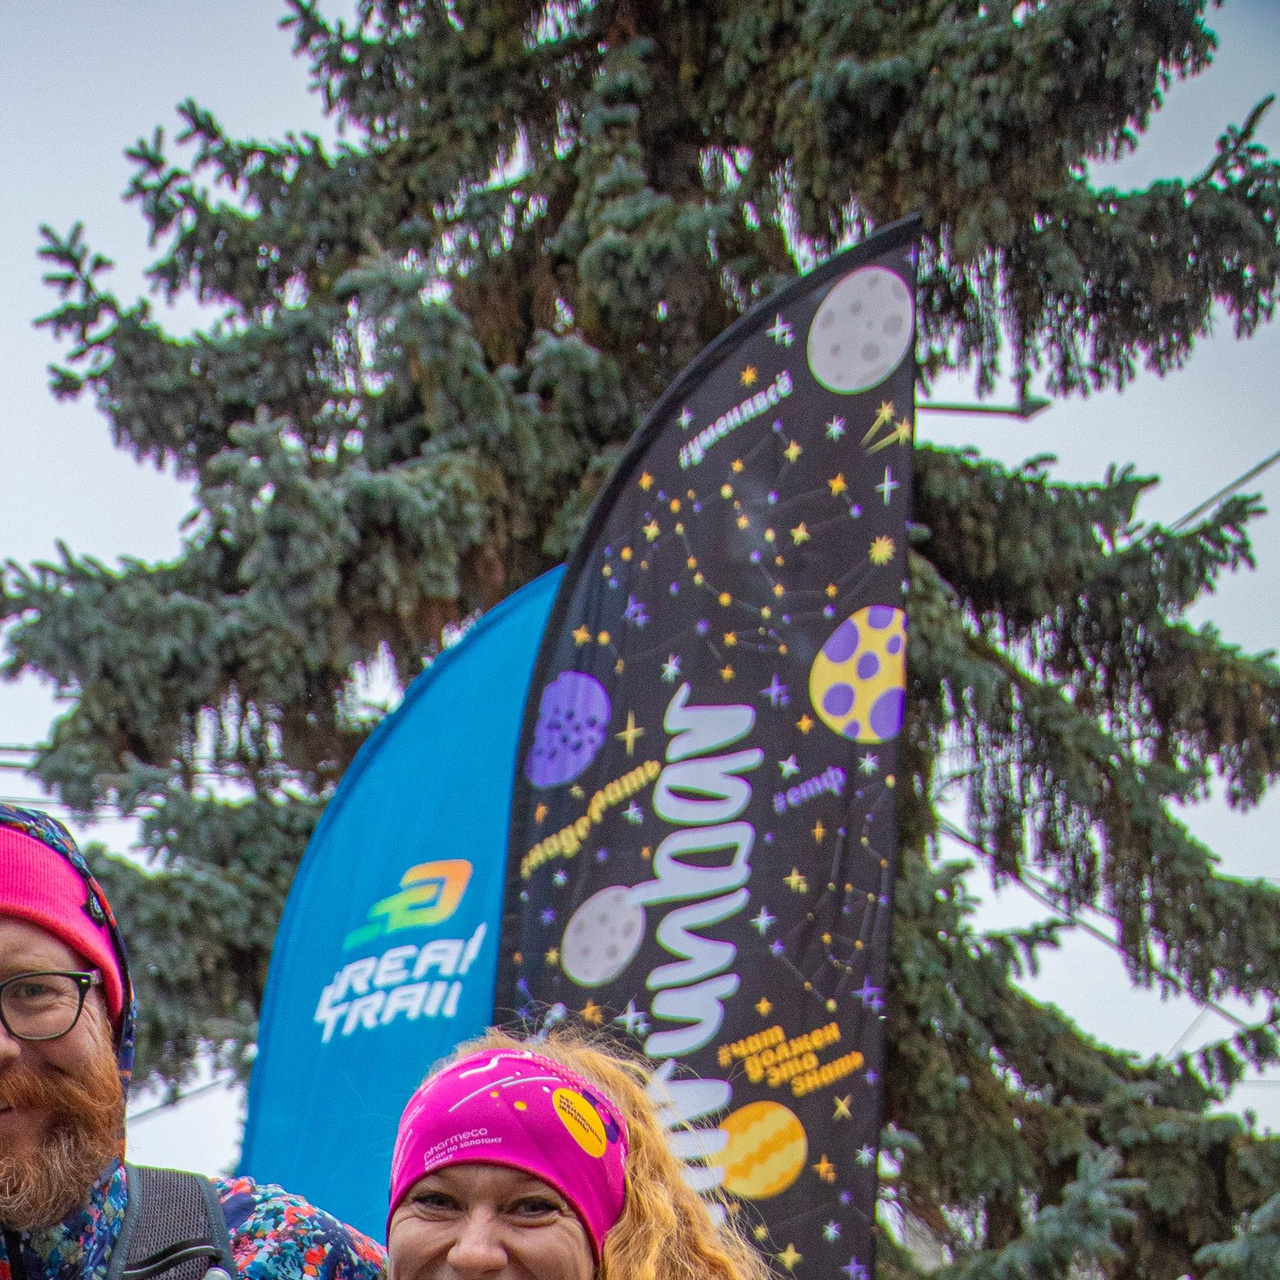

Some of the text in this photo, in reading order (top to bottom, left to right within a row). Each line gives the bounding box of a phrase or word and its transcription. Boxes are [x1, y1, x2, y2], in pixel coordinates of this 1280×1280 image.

[744, 1021, 842, 1084] должен
[766, 1051, 819, 1088] это
[791, 1050, 865, 1098] знать
[423, 1127, 488, 1163] pharmeco
[447, 1144, 459, 1154] ПО
[459, 1136, 503, 1149] ЗОЛОТОМУ
